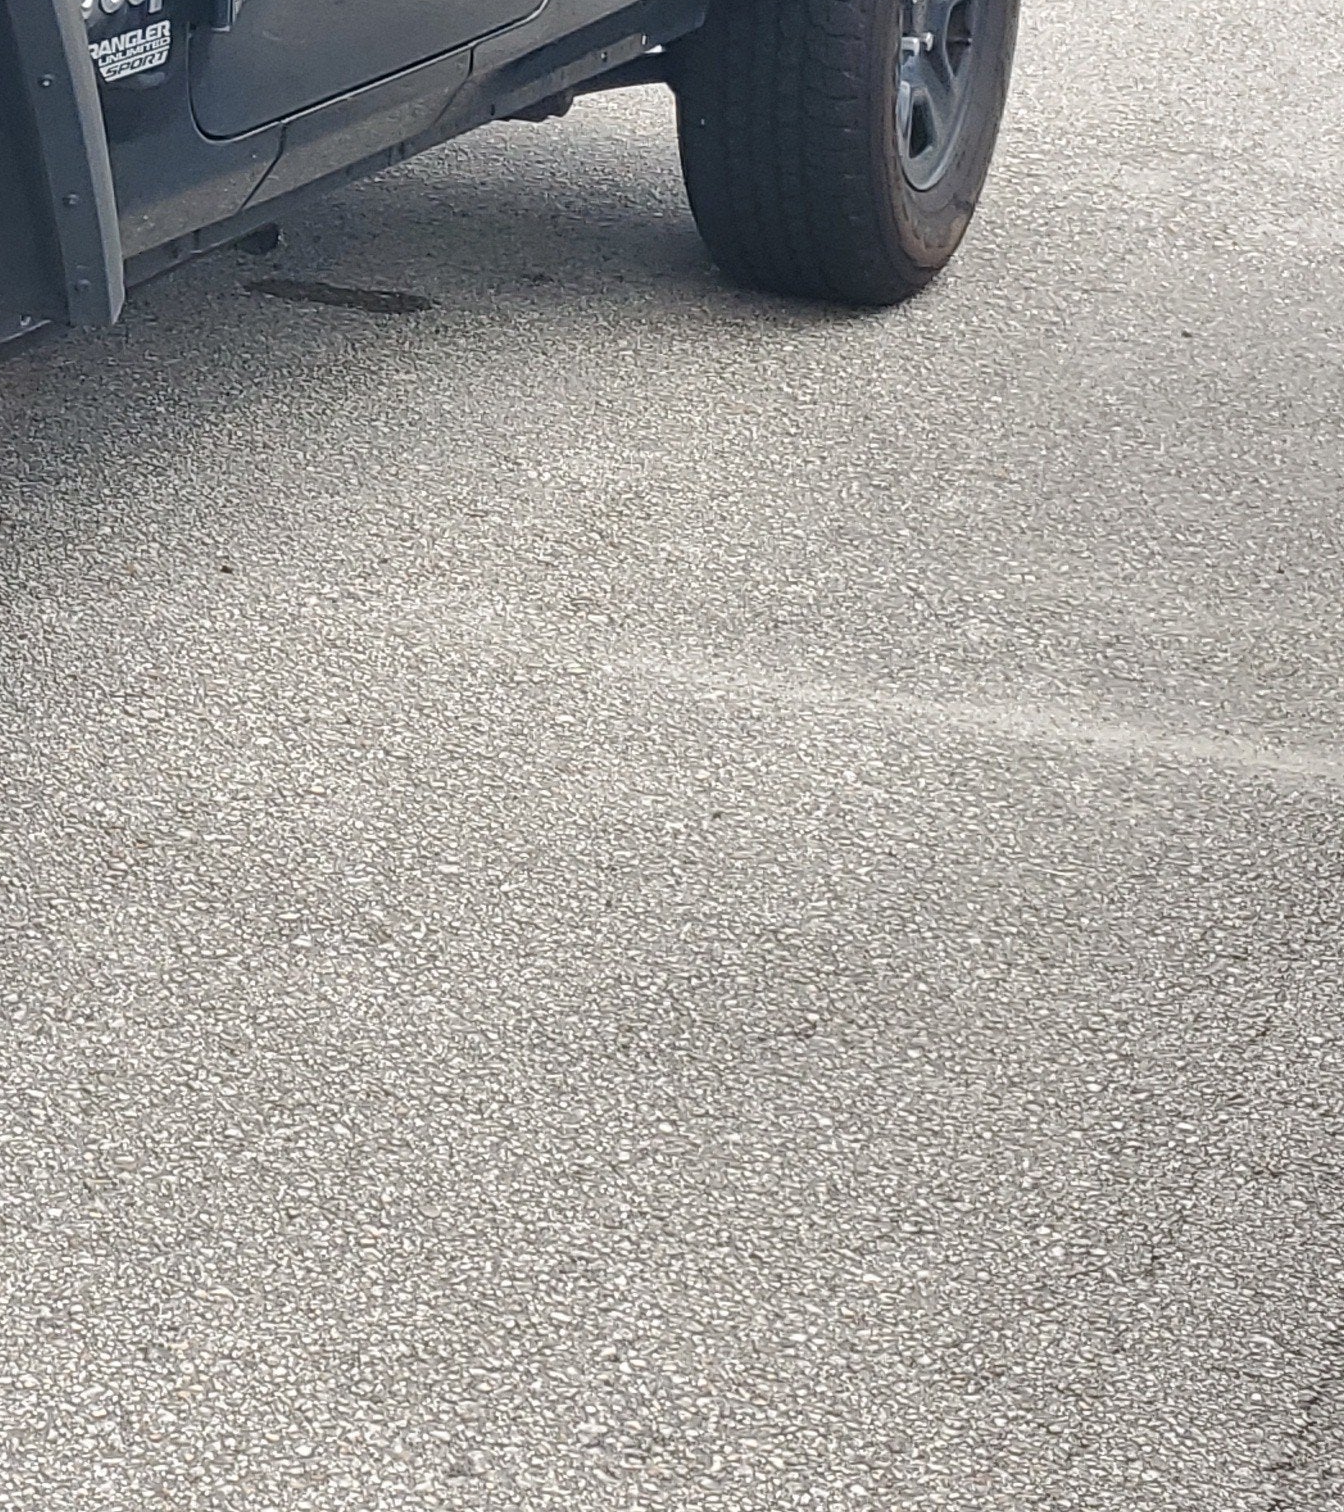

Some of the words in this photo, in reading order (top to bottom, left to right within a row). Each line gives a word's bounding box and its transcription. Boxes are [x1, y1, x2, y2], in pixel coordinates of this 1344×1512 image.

[88, 19, 171, 60] RANGLER
[98, 37, 171, 66] UNLIMITED
[104, 50, 169, 77] SPORT
